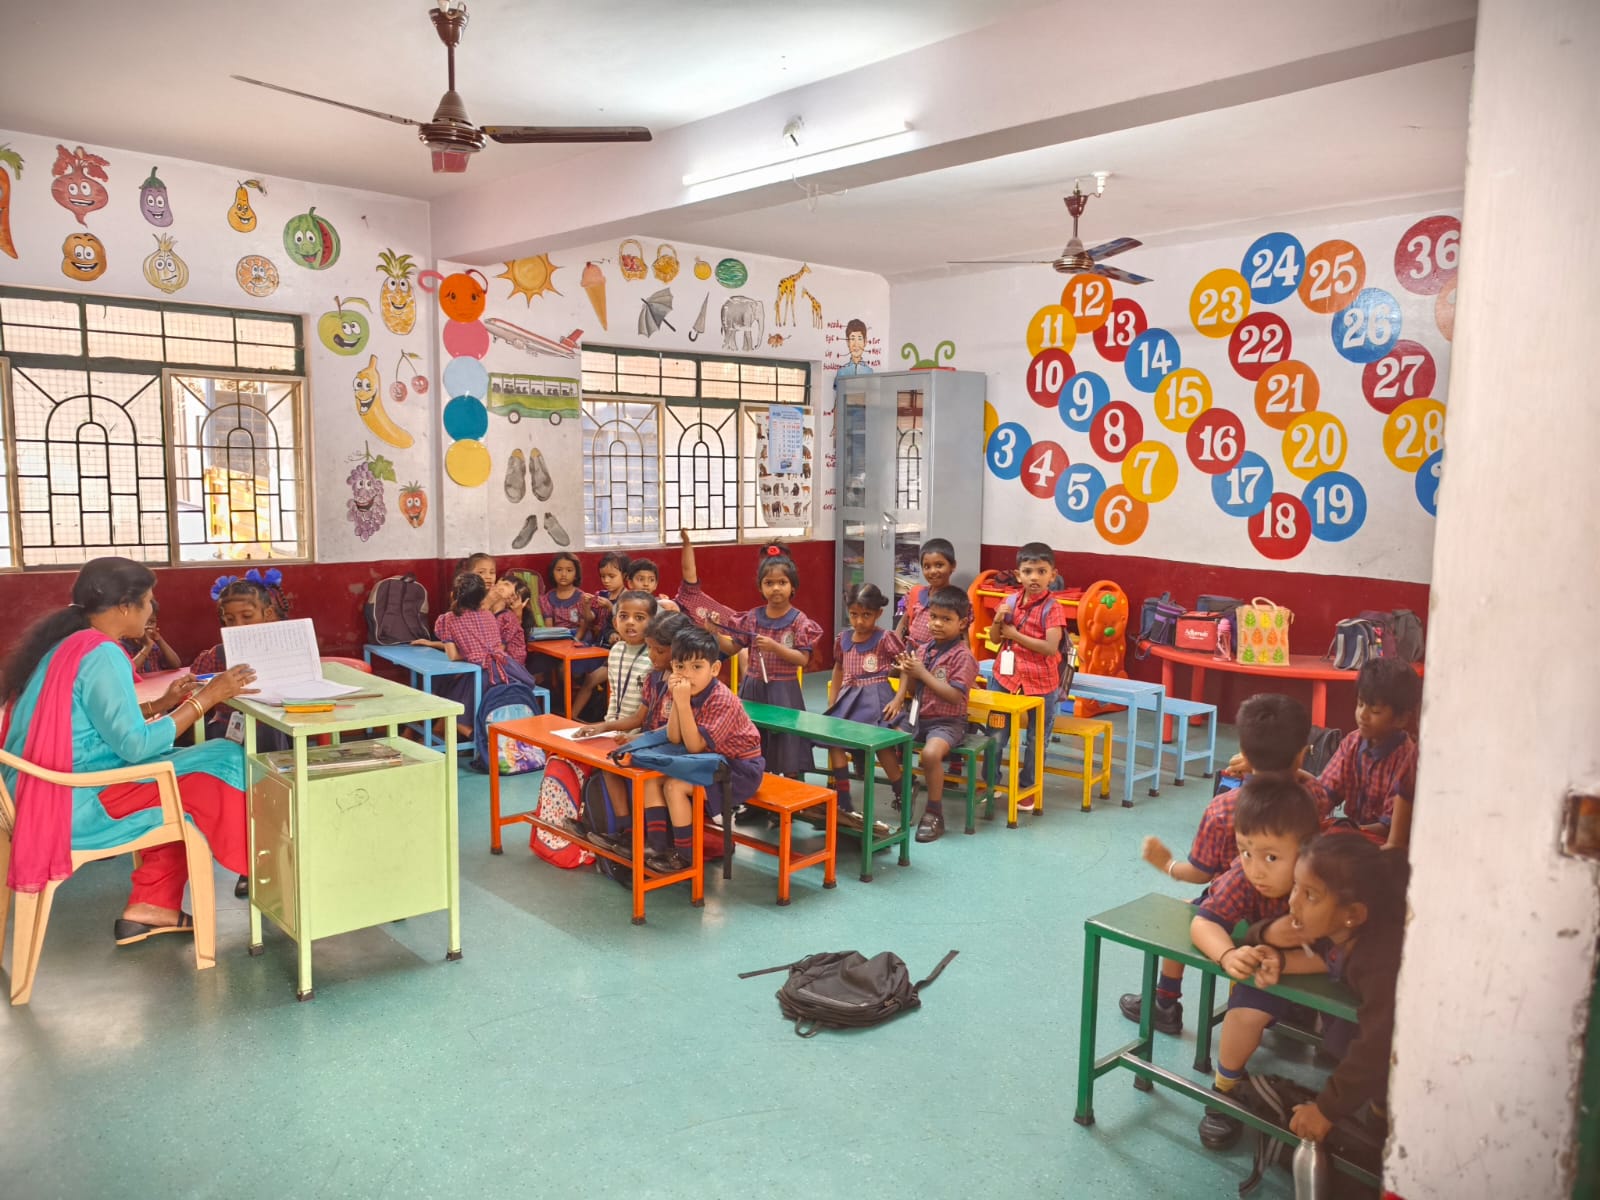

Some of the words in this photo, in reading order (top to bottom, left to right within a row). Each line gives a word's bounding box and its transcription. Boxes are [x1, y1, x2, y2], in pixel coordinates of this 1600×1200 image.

[1250, 245, 1299, 288] 24
[1406, 229, 1459, 280] 36
[1309, 251, 1357, 300] 25
[1072, 281, 1105, 317] 12
[1197, 287, 1243, 325] 23
[1040, 314, 1064, 348] 11
[1105, 309, 1137, 347] 13
[1237, 323, 1283, 363] 22
[1342, 301, 1392, 347] 26
[1034, 359, 1064, 394] 10
[1139, 339, 1172, 378] 14
[1373, 354, 1425, 398] 27
[1069, 377, 1094, 421] 9
[1166, 377, 1203, 420] 15
[1266, 374, 1304, 413] 21
[993, 428, 1016, 468] 3
[1103, 408, 1126, 453] 8
[1198, 425, 1237, 462] 16
[1292, 423, 1341, 468] 20
[1395, 409, 1443, 458] 28
[1028, 449, 1055, 487] 4
[1132, 451, 1159, 494] 7
[1226, 466, 1264, 505] 17
[1066, 473, 1091, 511] 5
[1313, 484, 1353, 525] 19
[1103, 494, 1133, 533] 6
[1258, 502, 1297, 539] 18
